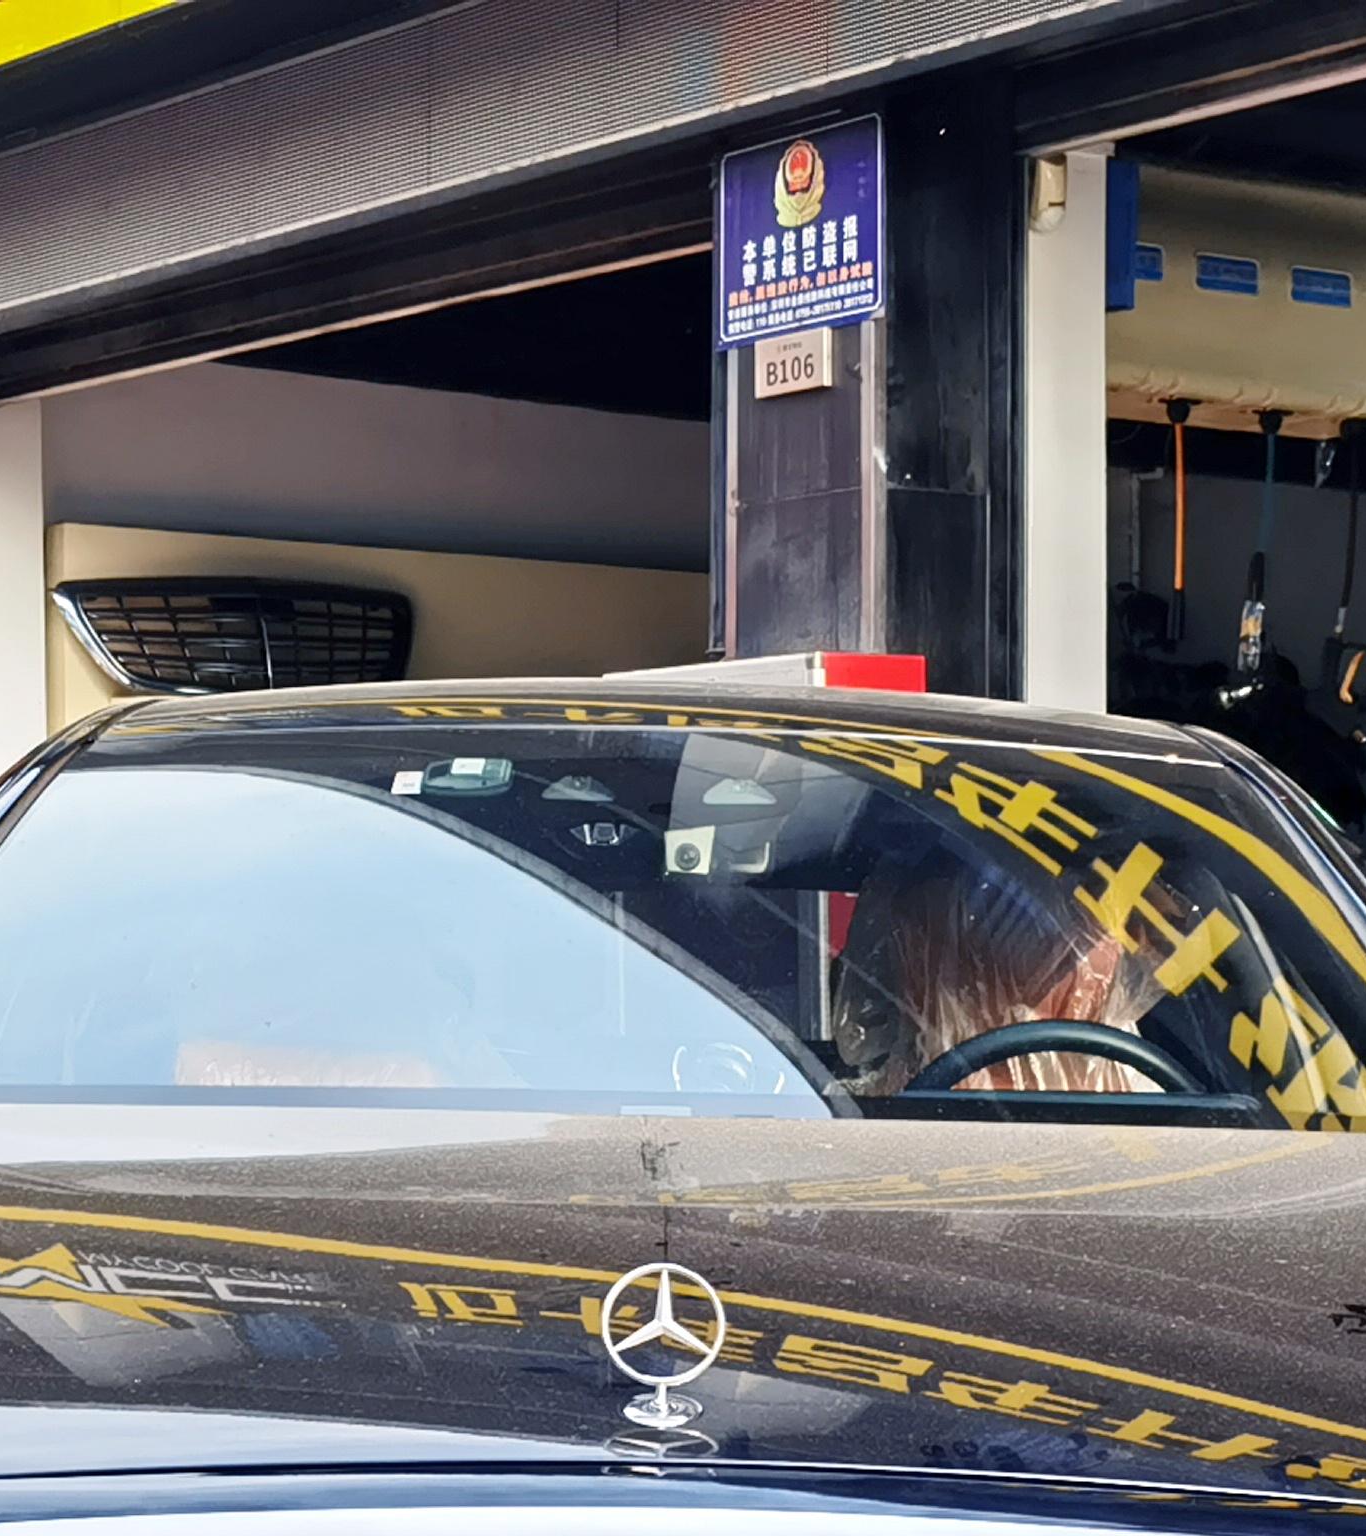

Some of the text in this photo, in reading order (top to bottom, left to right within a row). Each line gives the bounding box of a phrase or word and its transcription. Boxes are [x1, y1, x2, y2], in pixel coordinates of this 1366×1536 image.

[742, 215, 858, 263] 本单位防盗报
[742, 239, 858, 287] 警系统已联网
[766, 353, 814, 386] B106
